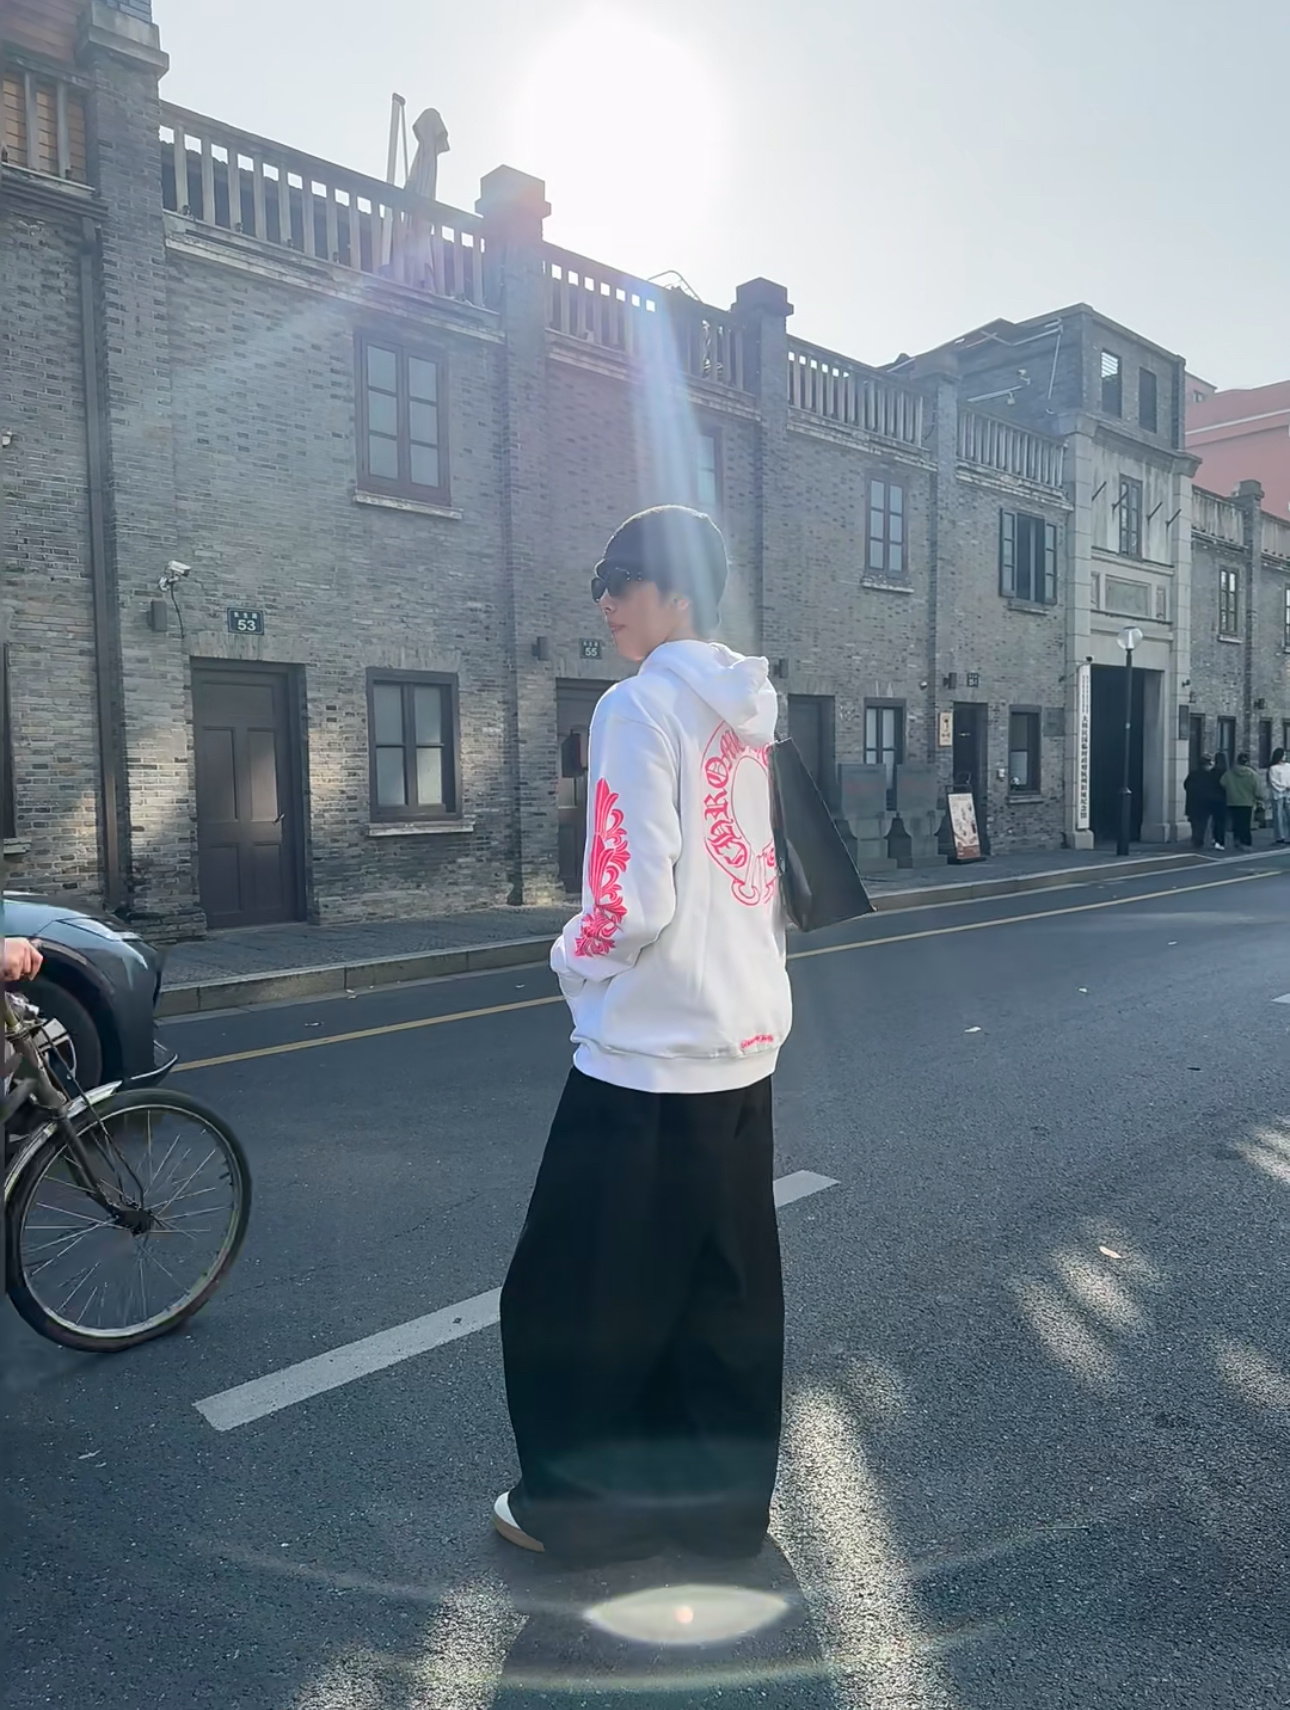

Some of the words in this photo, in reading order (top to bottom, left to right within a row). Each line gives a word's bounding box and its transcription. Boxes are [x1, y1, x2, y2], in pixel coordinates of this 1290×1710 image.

[237, 619, 257, 631] 53
[585, 647, 598, 656] 55
[704, 729, 749, 868] CHROM
